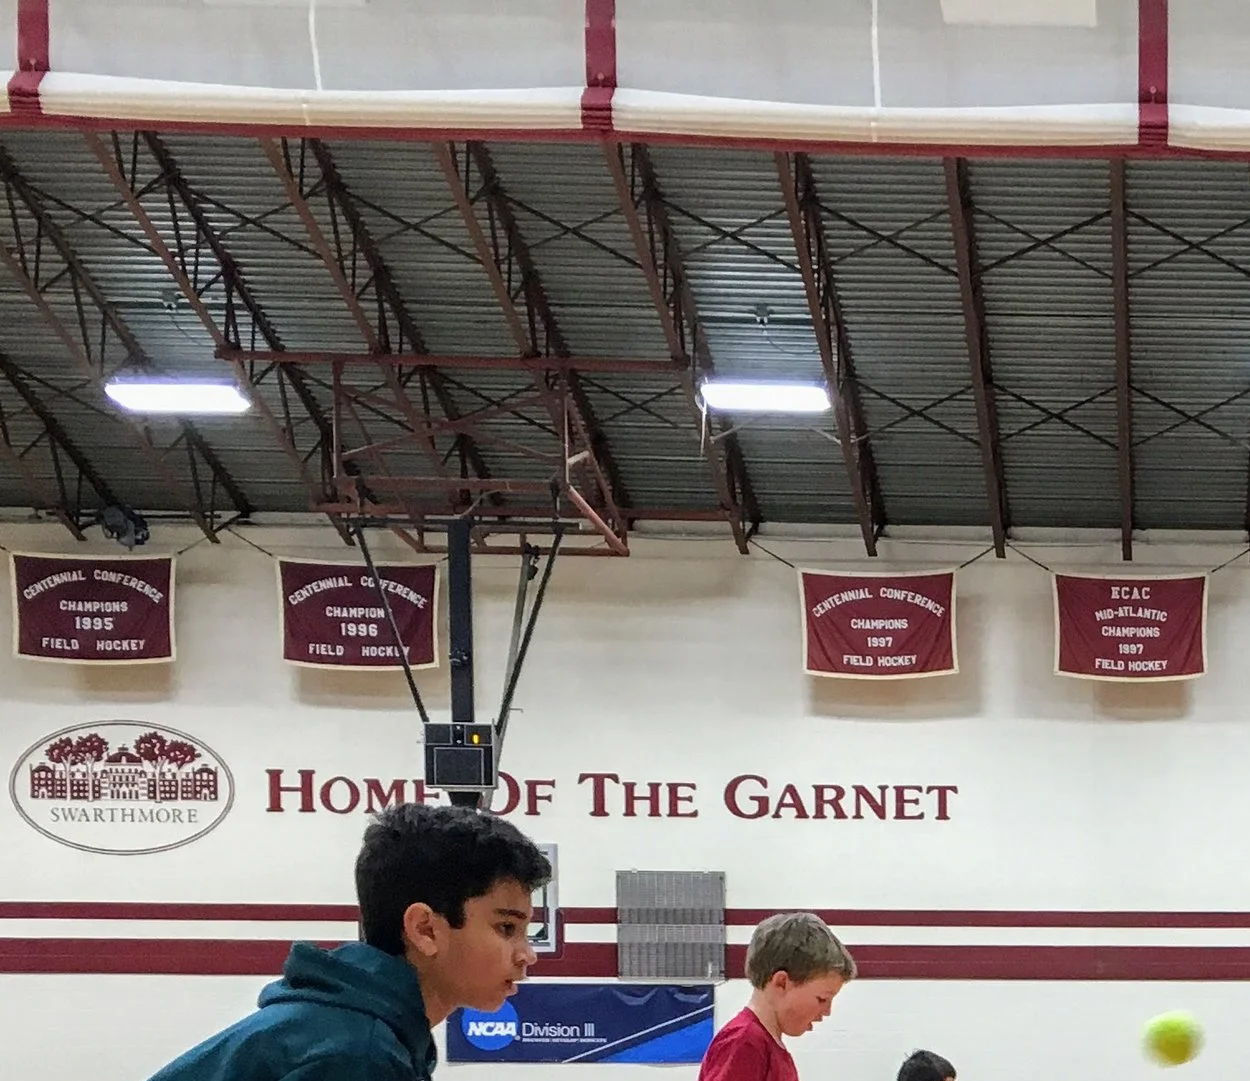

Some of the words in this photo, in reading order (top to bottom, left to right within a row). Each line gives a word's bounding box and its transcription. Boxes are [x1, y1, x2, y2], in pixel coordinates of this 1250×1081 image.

[23, 570, 86, 600] CENTENNIAL
[94, 569, 164, 604] CONFERENCE
[288, 575, 353, 606] CENTENNIAL
[1110, 586, 1151, 600] ECAC
[59, 600, 128, 612] CHAMPIONS
[812, 587, 873, 618] CENTENNIAL
[879, 587, 946, 618] CONFERENCE
[1095, 606, 1168, 622] MID-ATLANTIC
[75, 616, 114, 630] 1995
[340, 623, 378, 637] 1996
[850, 618, 909, 630] CHAMPIONS
[1101, 626, 1161, 638] CHAMPIONS
[42, 637, 80, 650] FIELD
[96, 639, 146, 651] HOCKEY
[867, 636, 893, 648] 1997
[1118, 643, 1144, 655] 1997
[308, 643, 345, 656] FIELD
[843, 655, 874, 666] FIELD
[877, 654, 917, 667] HOCKEY
[1095, 658, 1125, 671] FIELD
[1128, 659, 1168, 672] HOCKEY
[577, 772, 699, 819] THE
[723, 774, 959, 821] GARNET
[50, 807, 199, 824] SWARTHMORE
[467, 1021, 517, 1036] NCAA
[521, 1022, 580, 1037] Division
[584, 1023, 595, 1037] III
